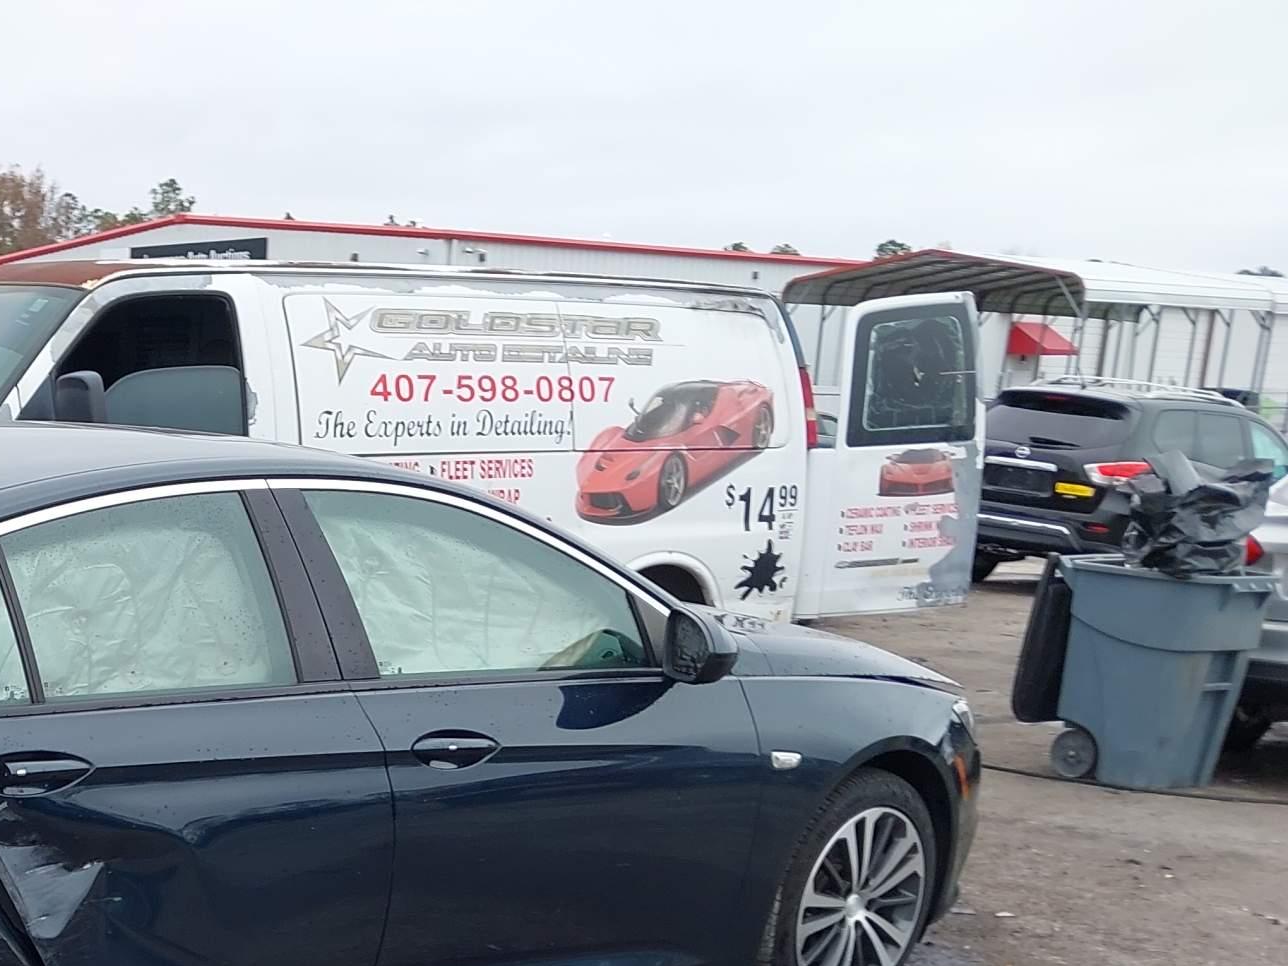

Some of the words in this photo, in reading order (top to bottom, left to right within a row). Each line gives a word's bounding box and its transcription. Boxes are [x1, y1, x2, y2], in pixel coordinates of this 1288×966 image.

[370, 307, 663, 342] GOLDSTAR
[403, 342, 497, 362] AUTO
[370, 374, 616, 402] 407-598-0807
[314, 410, 357, 439] The
[364, 410, 442, 446] Experts
[450, 413, 469, 436] in
[475, 410, 574, 444] Detailing!
[440, 460, 476, 480] FLEET
[479, 458, 534, 479] SERVICES
